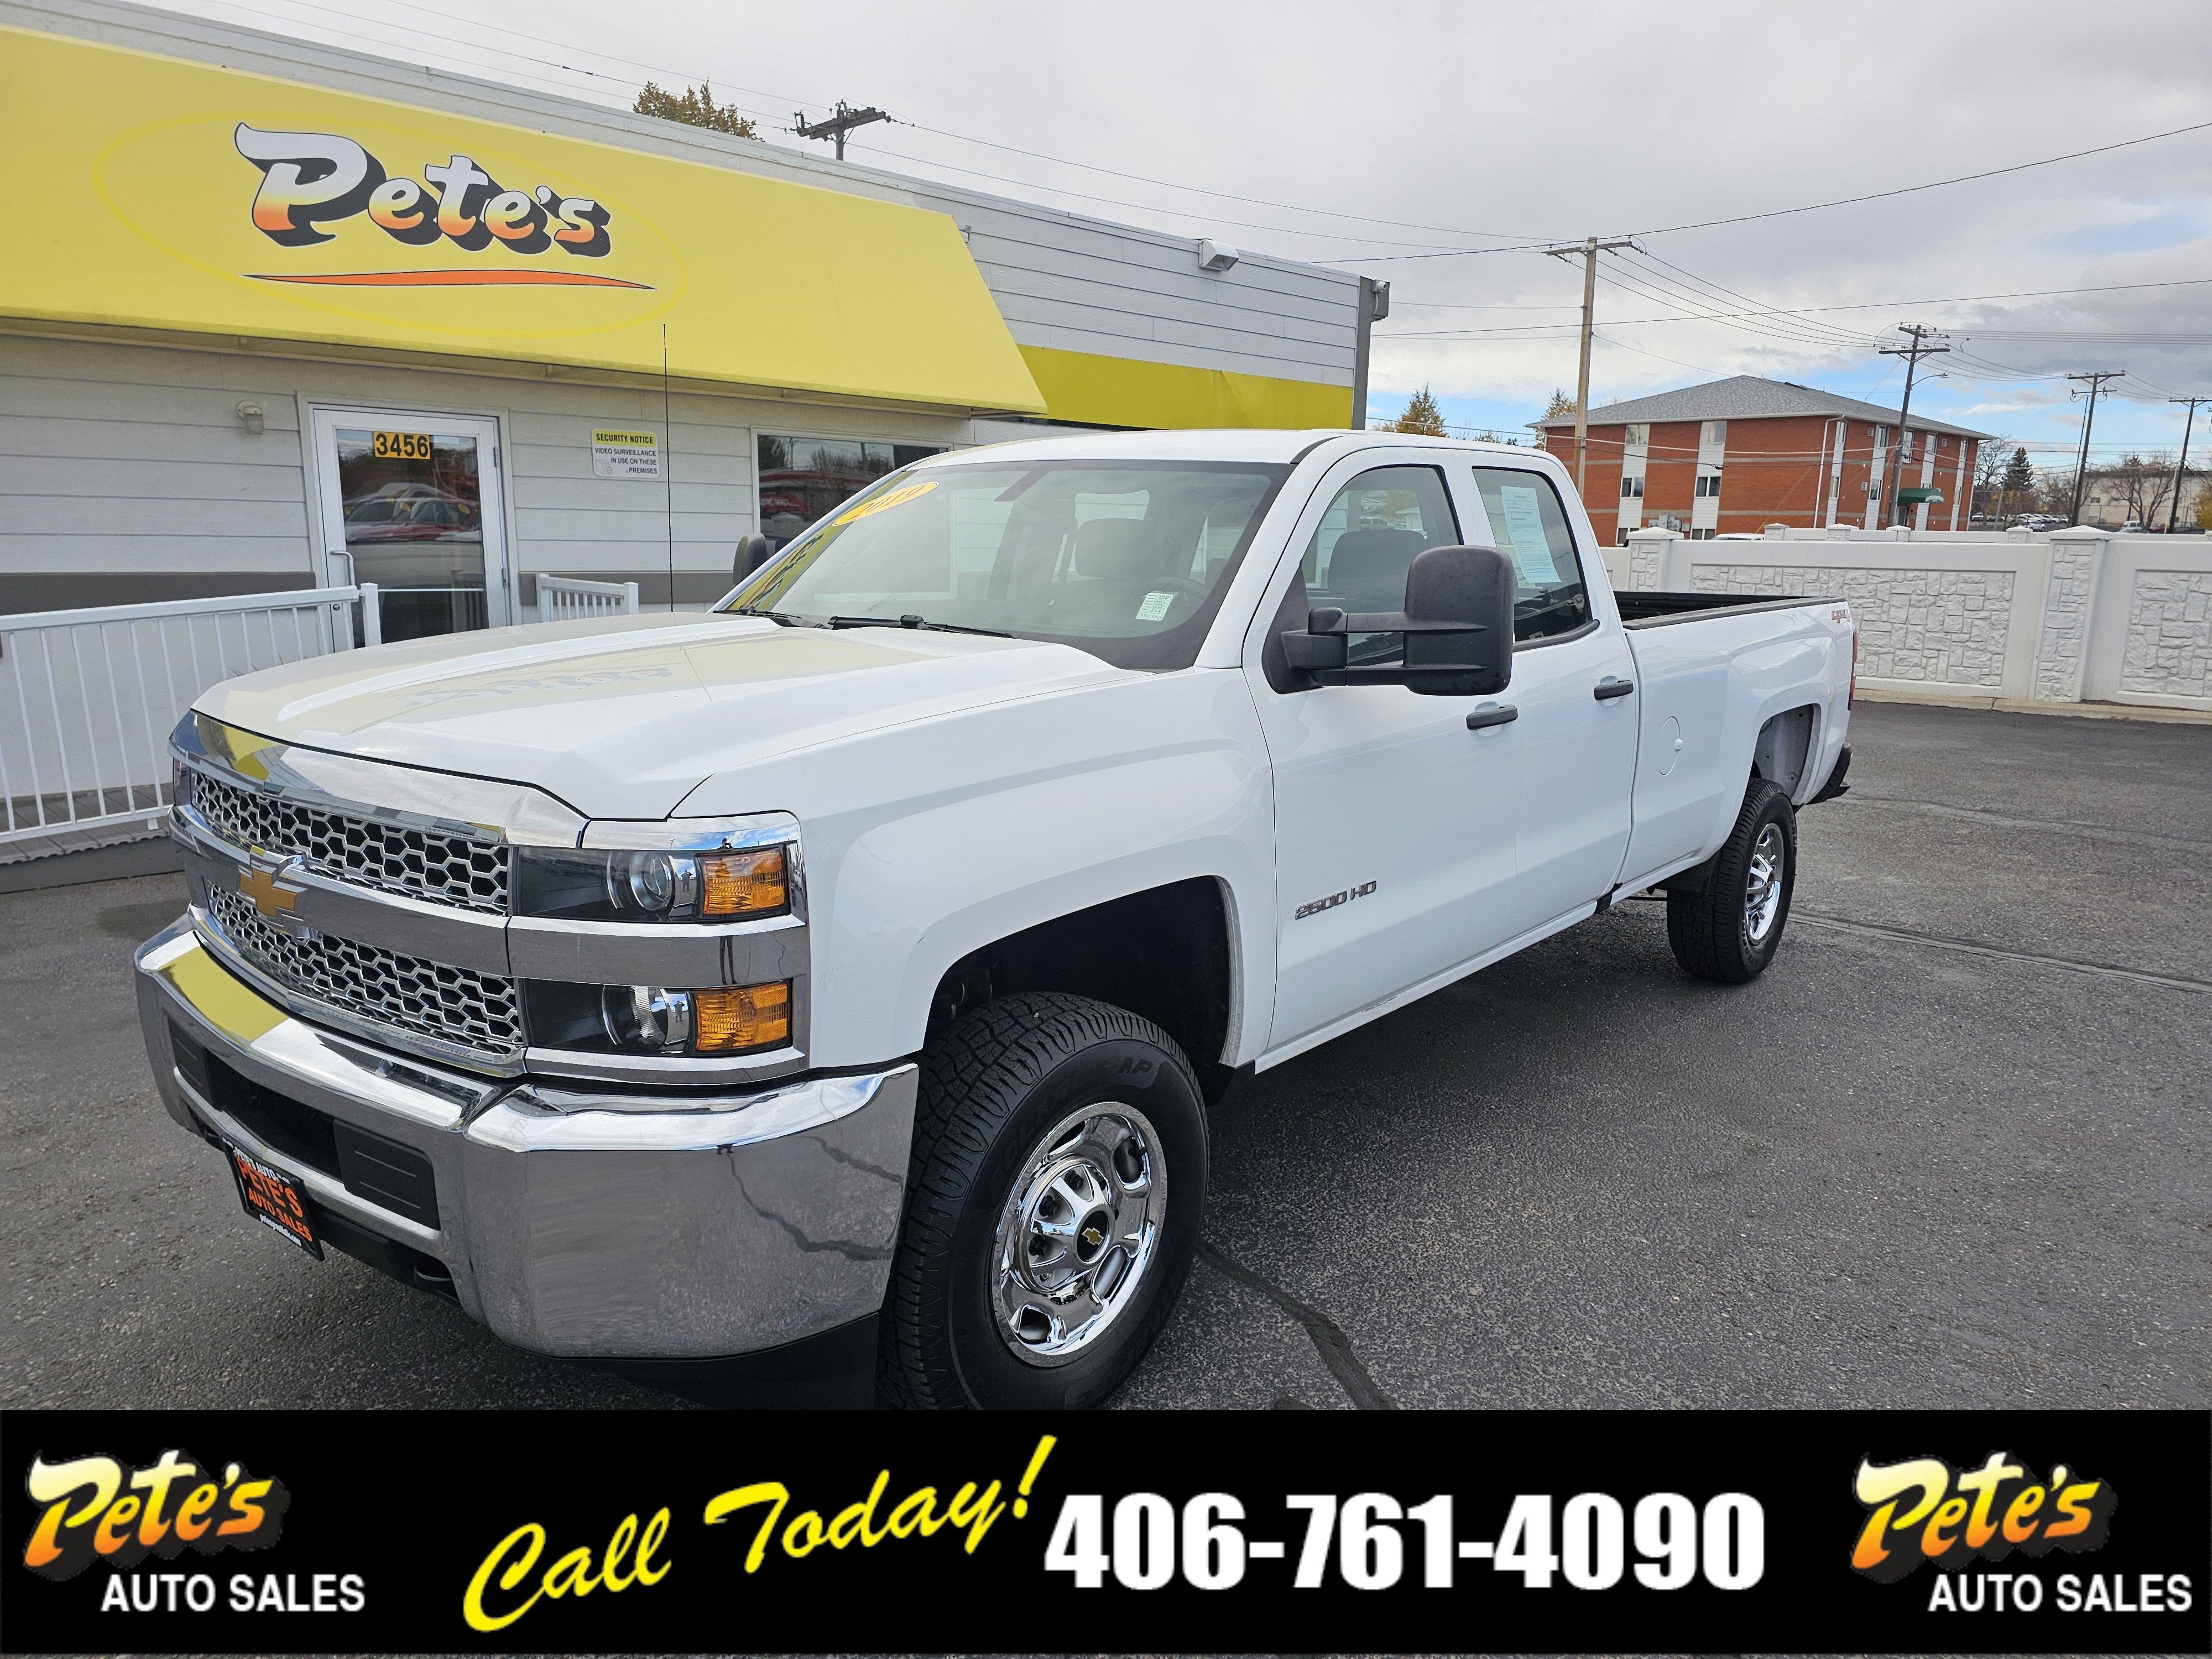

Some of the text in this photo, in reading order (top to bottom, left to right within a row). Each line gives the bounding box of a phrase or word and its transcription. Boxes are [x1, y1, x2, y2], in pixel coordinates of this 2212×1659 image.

[234, 121, 612, 258] Pete's
[375, 432, 429, 457] 3456
[596, 434, 653, 444] SECURITY NOTICE
[1295, 880, 1377, 920] 2500 HD
[248, 1187, 276, 1216] AUTO
[276, 1208, 312, 1242] SALES
